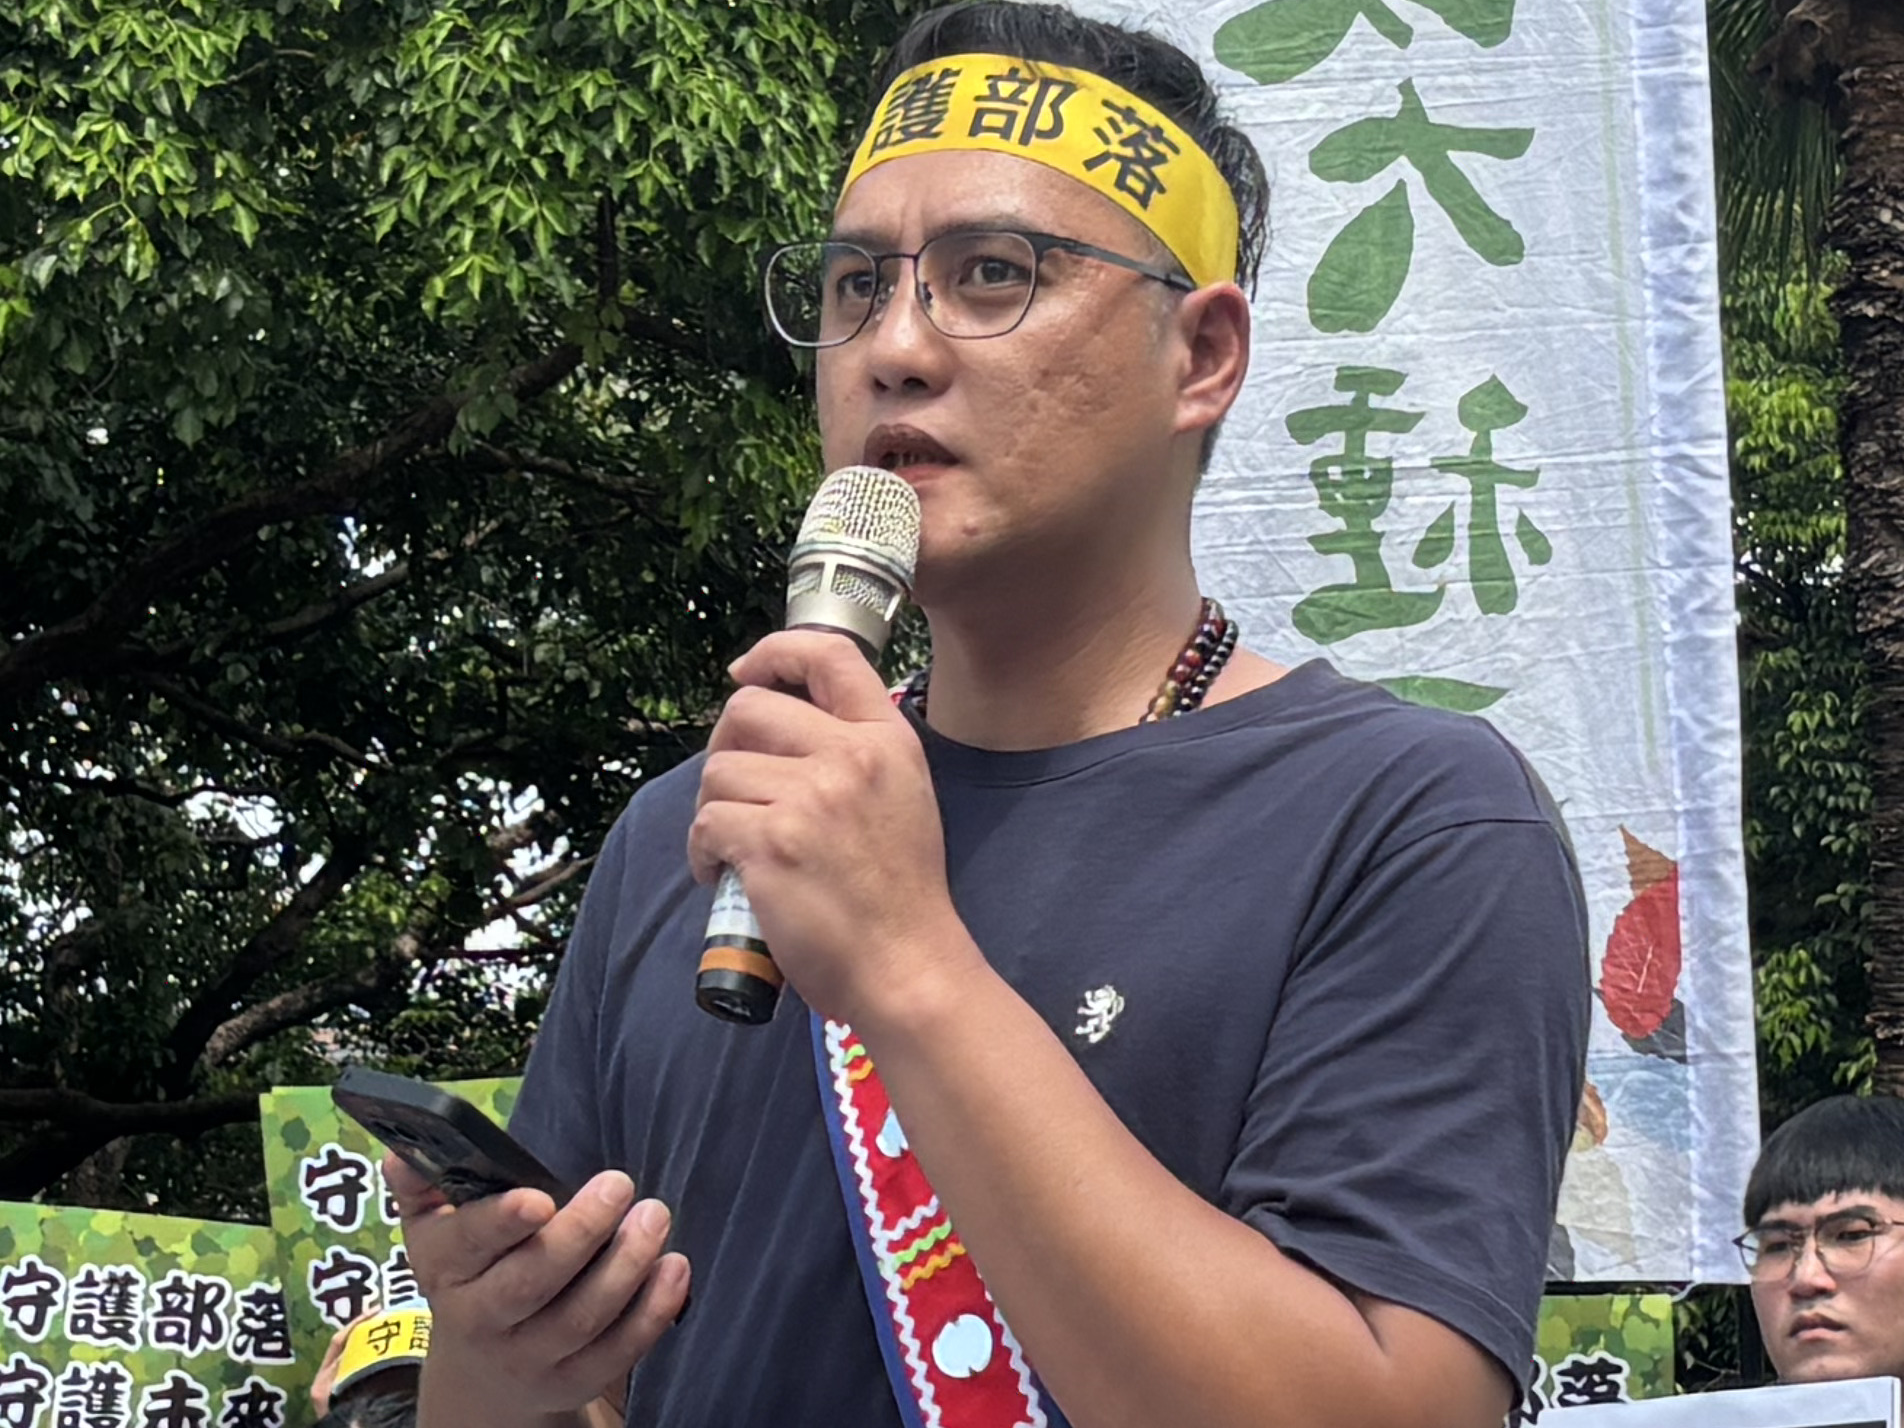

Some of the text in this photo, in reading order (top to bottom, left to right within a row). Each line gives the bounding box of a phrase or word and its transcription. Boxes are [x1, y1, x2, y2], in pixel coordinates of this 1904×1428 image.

[866, 67, 1181, 212] 護部落
[2, 1261, 292, 1360] 守護部落
